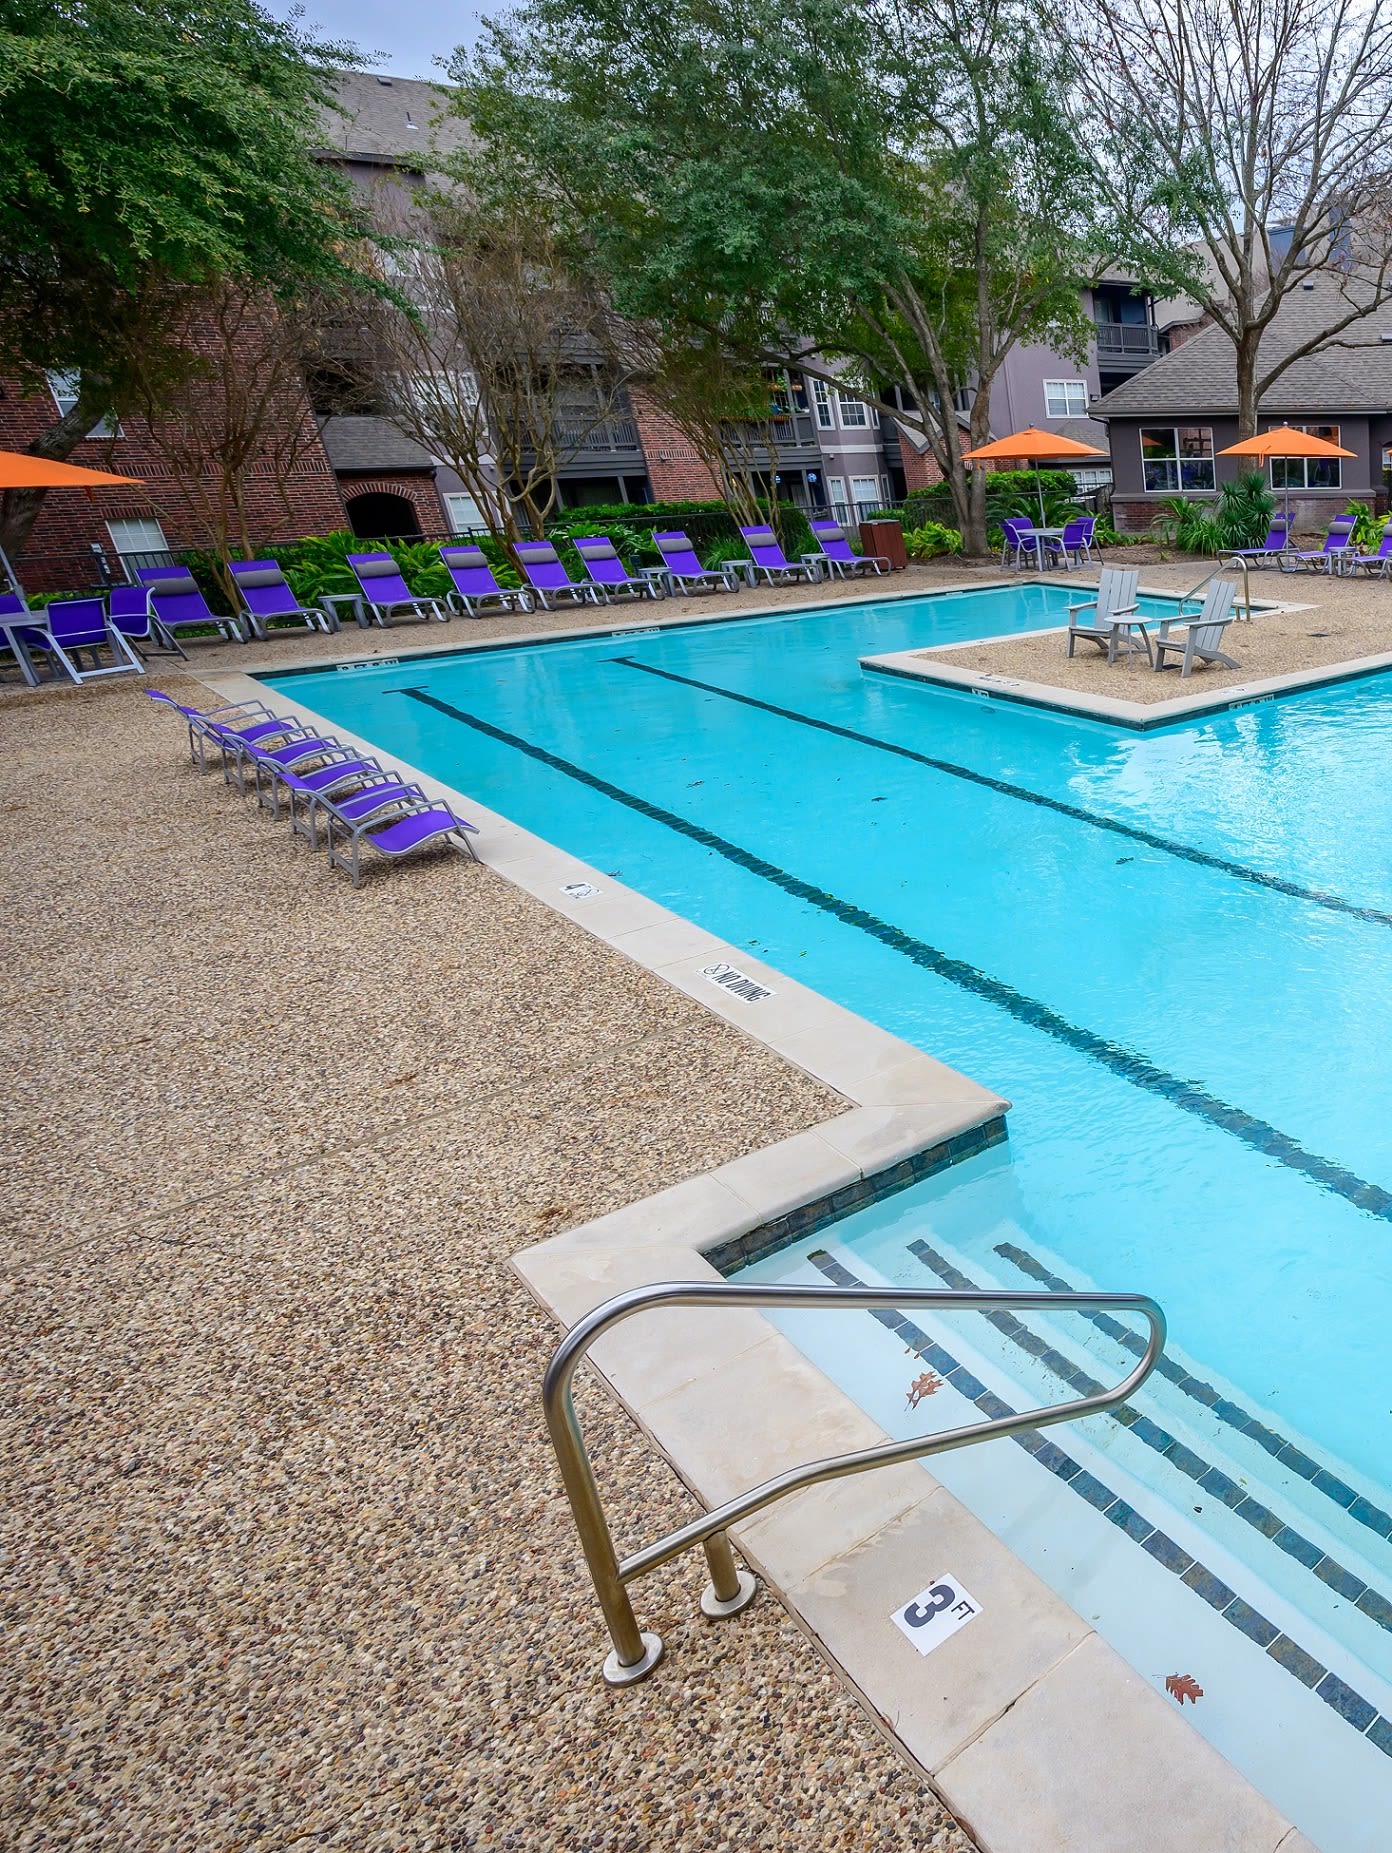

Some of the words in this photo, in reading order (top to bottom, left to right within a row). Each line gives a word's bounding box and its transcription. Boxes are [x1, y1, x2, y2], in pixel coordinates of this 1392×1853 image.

[711, 970, 742, 984] NO
[725, 979, 772, 1002] DIVING
[903, 1584, 956, 1628] 3
[950, 1600, 976, 1621] FT
